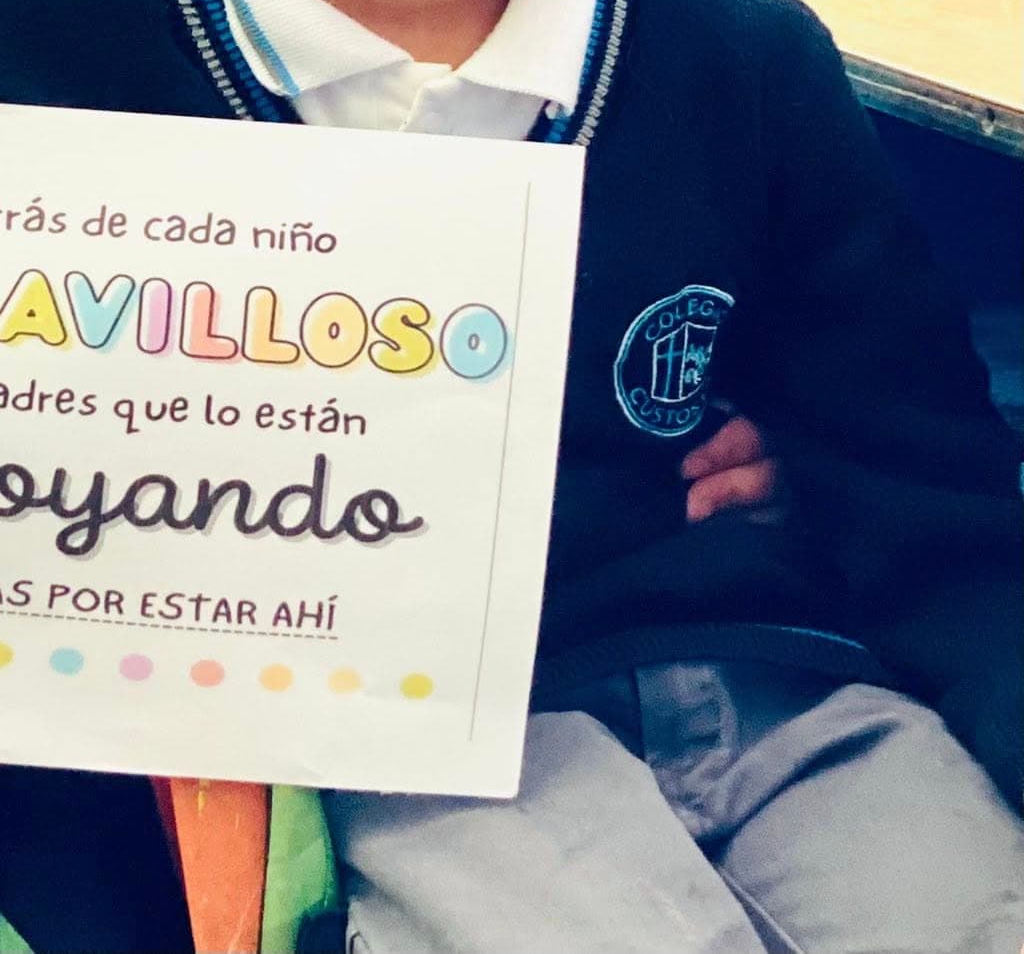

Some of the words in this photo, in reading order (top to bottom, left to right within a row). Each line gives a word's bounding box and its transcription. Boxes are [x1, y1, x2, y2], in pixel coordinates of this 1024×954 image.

[82, 205, 127, 238] de
[143, 212, 236, 246] cada
[252, 222, 337, 254] niño
[113, 396, 189, 435] que
[204, 394, 241, 427] lo
[255, 397, 367, 436] están
[47, 583, 125, 615] POR
[140, 592, 257, 626] ESTAR
[272, 594, 339, 631] AHÍ
